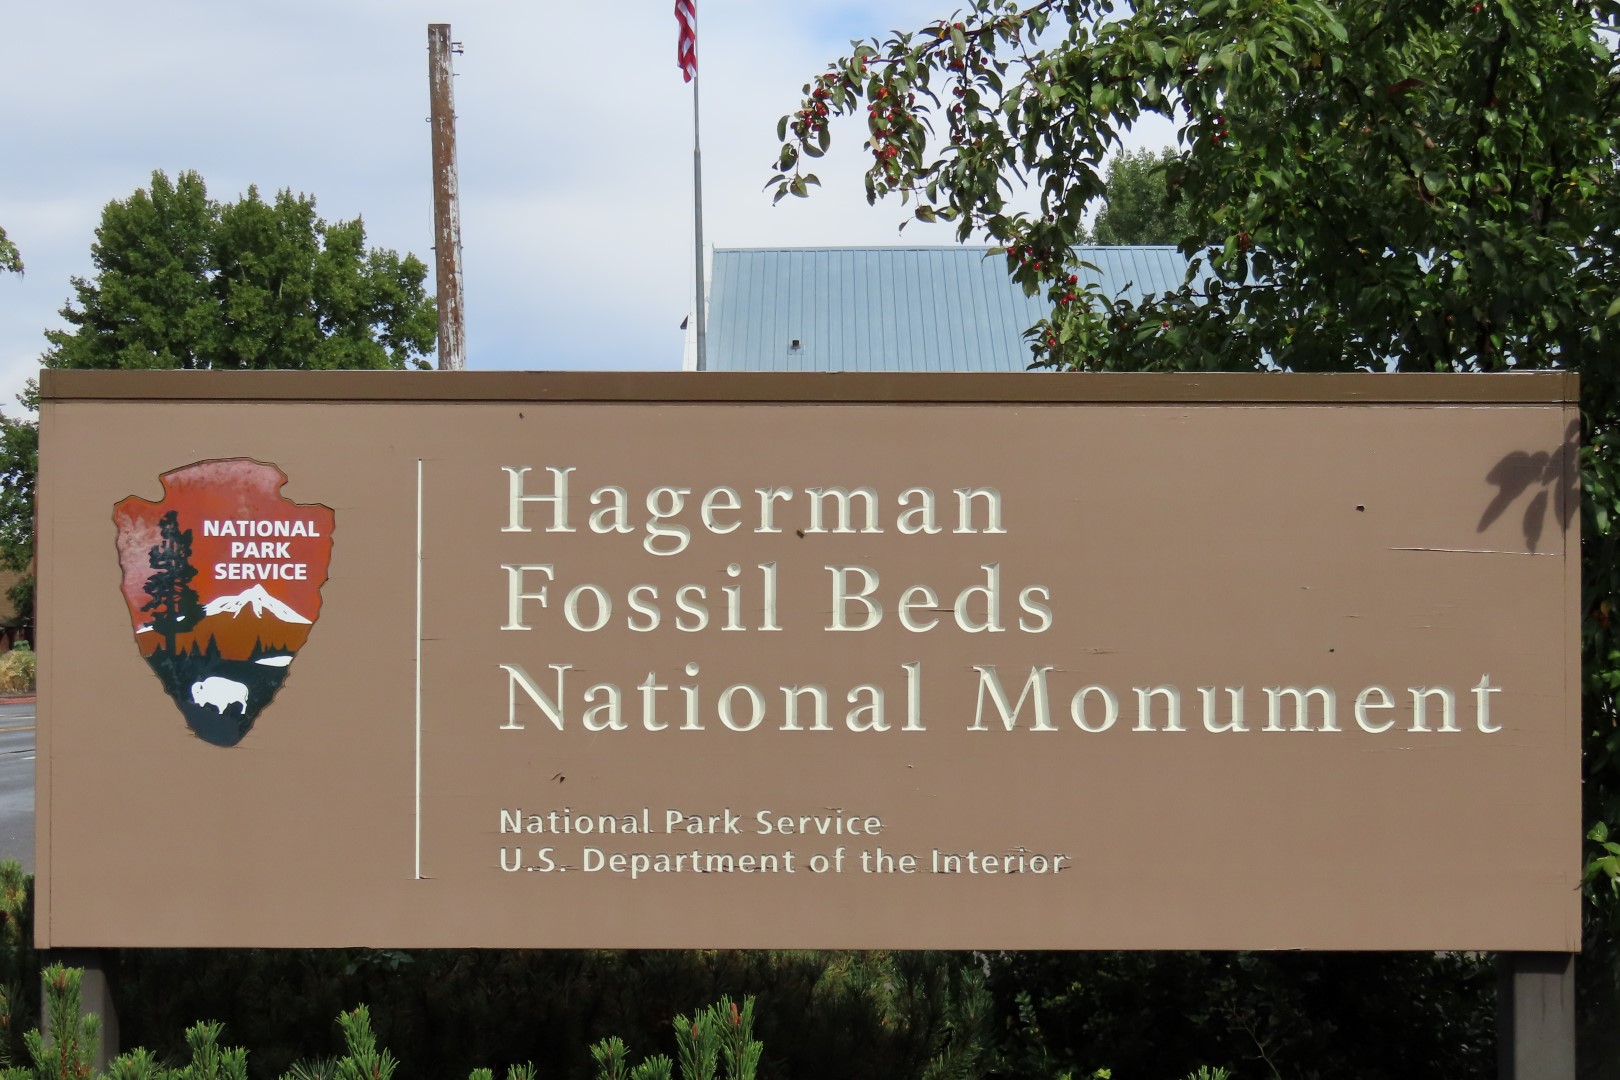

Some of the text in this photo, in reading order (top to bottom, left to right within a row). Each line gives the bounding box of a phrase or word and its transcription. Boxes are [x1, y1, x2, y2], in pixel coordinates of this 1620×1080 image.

[500, 465, 1008, 556] Hagerman
[203, 520, 320, 537] NATIONAL
[231, 541, 291, 559] PARK
[214, 562, 308, 581] SERVICE
[500, 563, 1054, 635] Fossil Beds
[499, 661, 1503, 735] National Monument
[499, 807, 882, 836] National Park Service
[499, 847, 1066, 880] U.S. Department of the Interior
